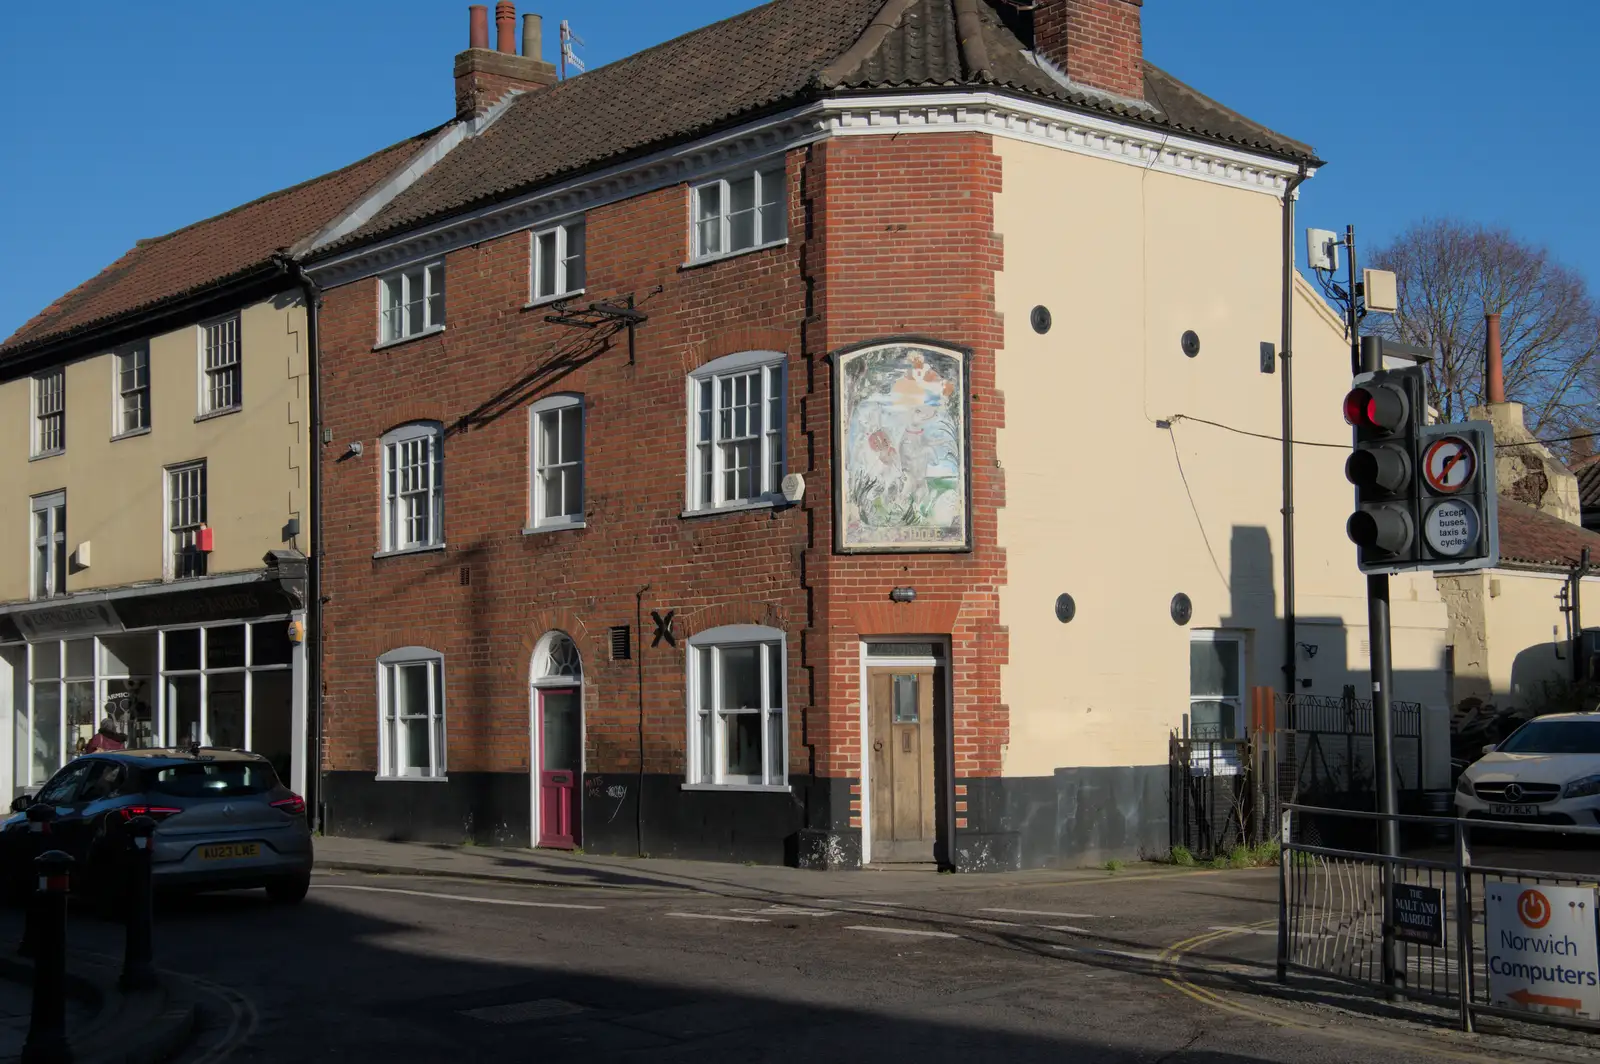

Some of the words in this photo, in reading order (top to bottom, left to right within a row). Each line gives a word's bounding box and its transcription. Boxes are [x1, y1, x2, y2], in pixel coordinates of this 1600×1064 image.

[1439, 508, 1467, 517] Except
[1439, 519, 1467, 527] buses,
[1439, 528, 1459, 537] taxis
[1461, 527, 1468, 536] &
[1440, 538, 1468, 548] cycles
[204, 846, 232, 859] AU23
[1408, 888, 1423, 900] THE
[1395, 898, 1418, 912] MALT
[1419, 901, 1437, 915] AND
[1400, 911, 1433, 927] MARDLE
[1500, 929, 1577, 956] Norwich
[1489, 955, 1597, 986] Computers
